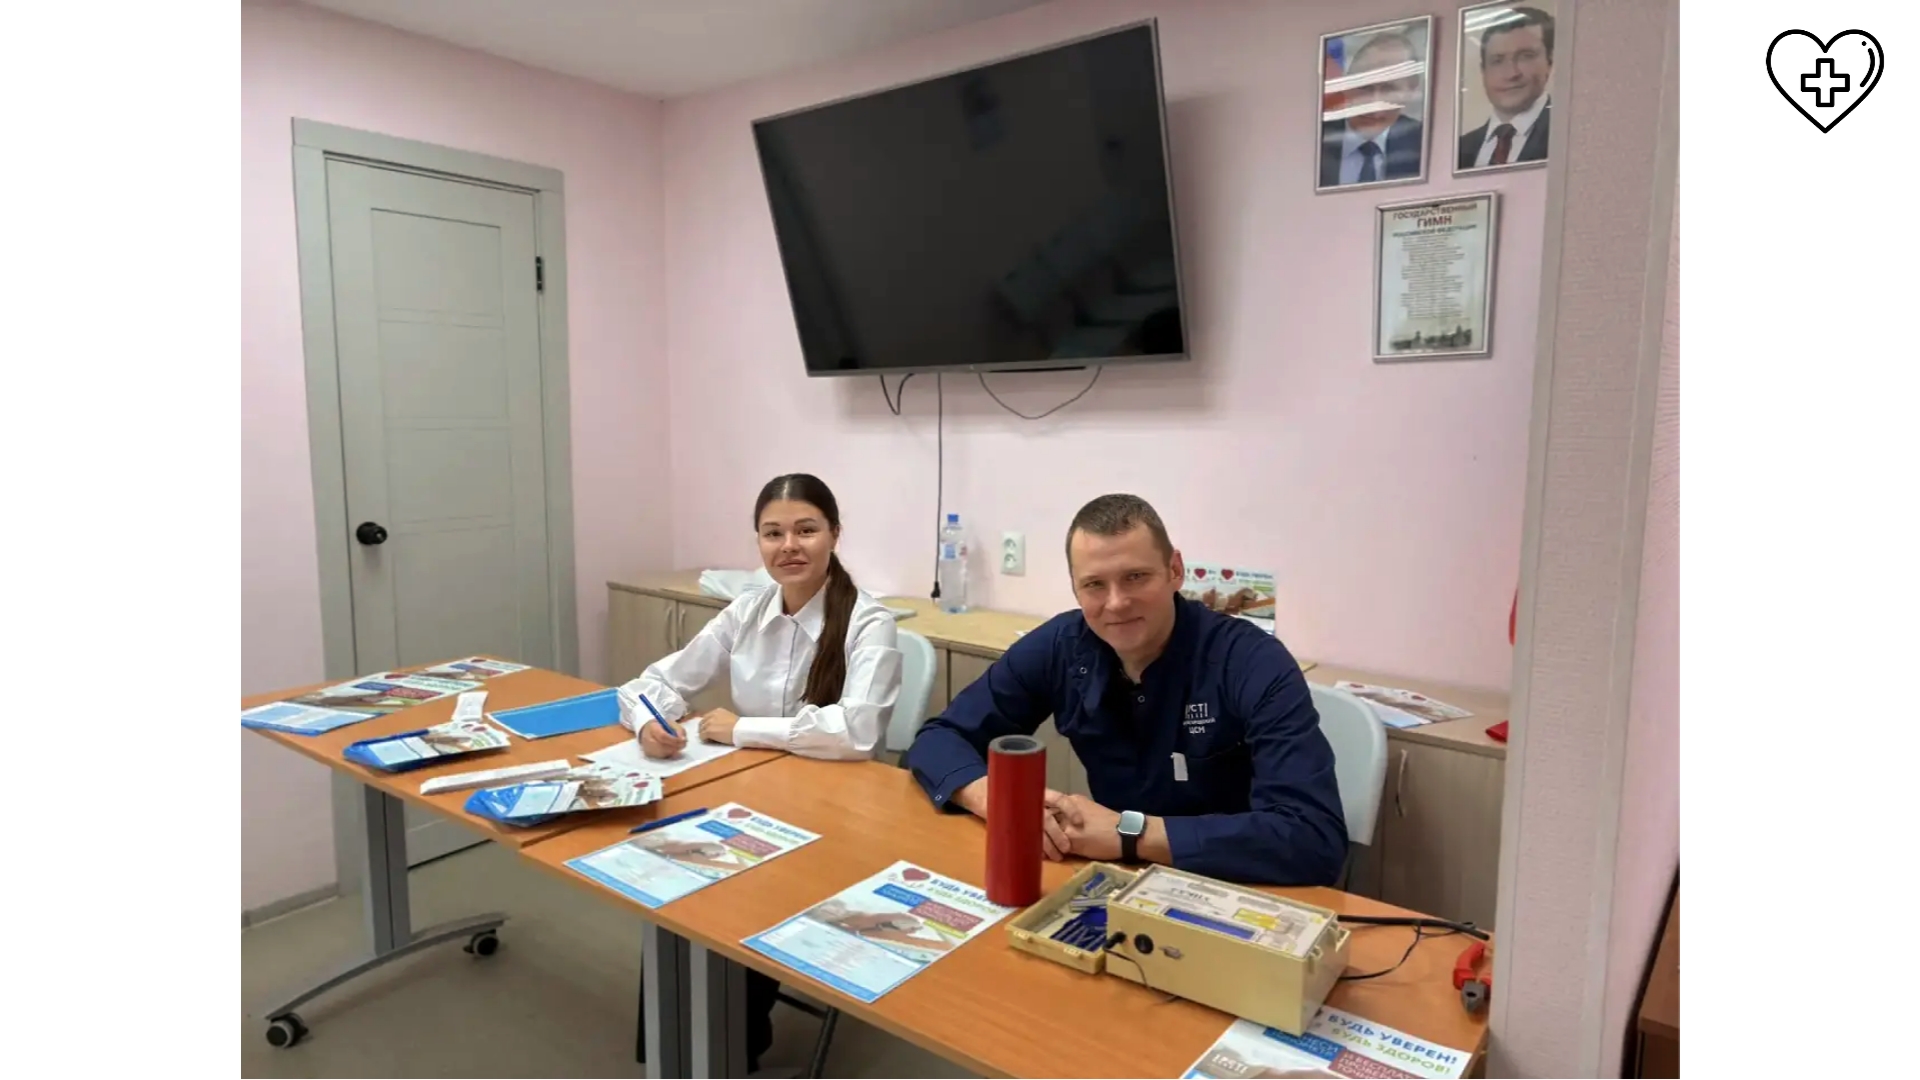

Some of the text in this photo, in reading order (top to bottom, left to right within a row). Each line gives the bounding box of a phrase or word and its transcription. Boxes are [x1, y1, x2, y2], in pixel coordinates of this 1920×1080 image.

[1417, 215, 1452, 228] ГИМН
[1189, 726, 1205, 735] ЦСМ
[1328, 1014, 1458, 1065] БУДЬ УВЕРЕН!
[1332, 1027, 1372, 1048] БУДЬ
[1375, 1043, 1451, 1074] ЗДОРОВ!
